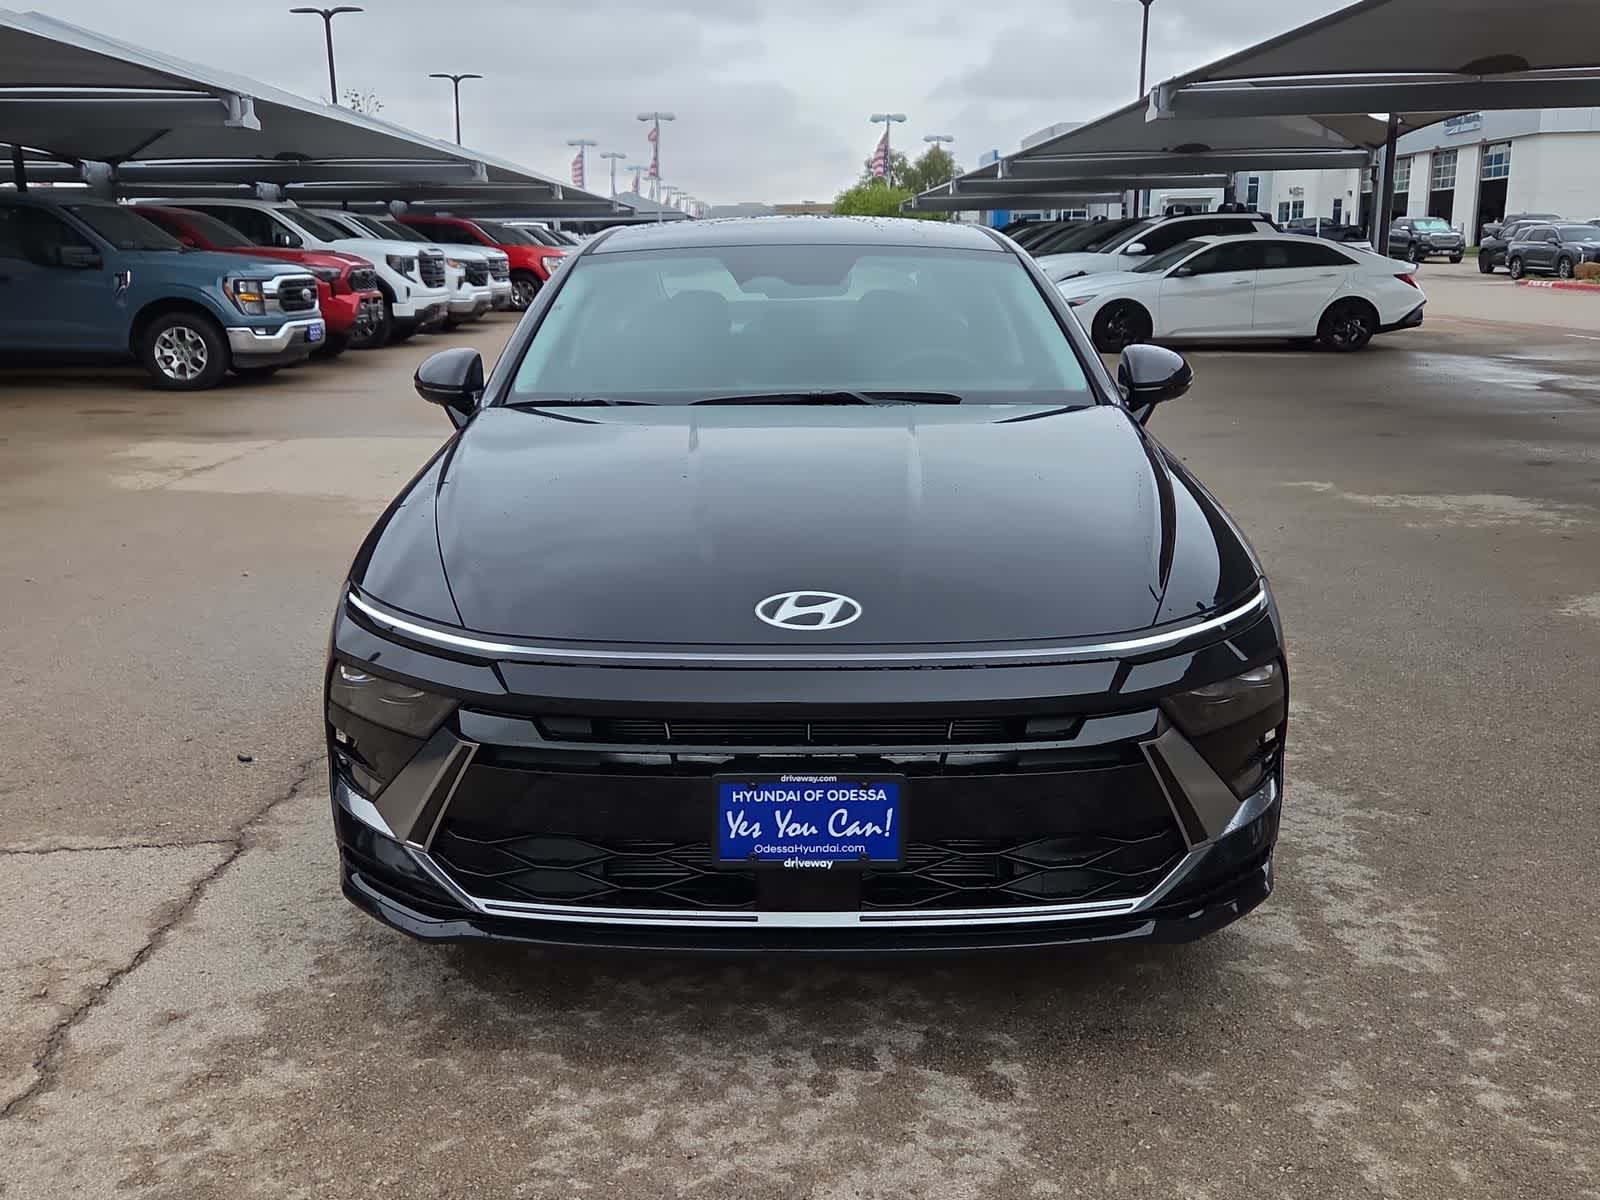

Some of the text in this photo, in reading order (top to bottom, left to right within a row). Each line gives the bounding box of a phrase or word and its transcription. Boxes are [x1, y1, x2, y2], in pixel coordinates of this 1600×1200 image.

[780, 774, 837, 783] driveway.com
[732, 789, 887, 802] HYUNDAI OF ODESSA
[726, 807, 893, 838] Yes You Can!
[754, 843, 866, 854] OdessaHyundai.com
[783, 856, 834, 869] driveway
